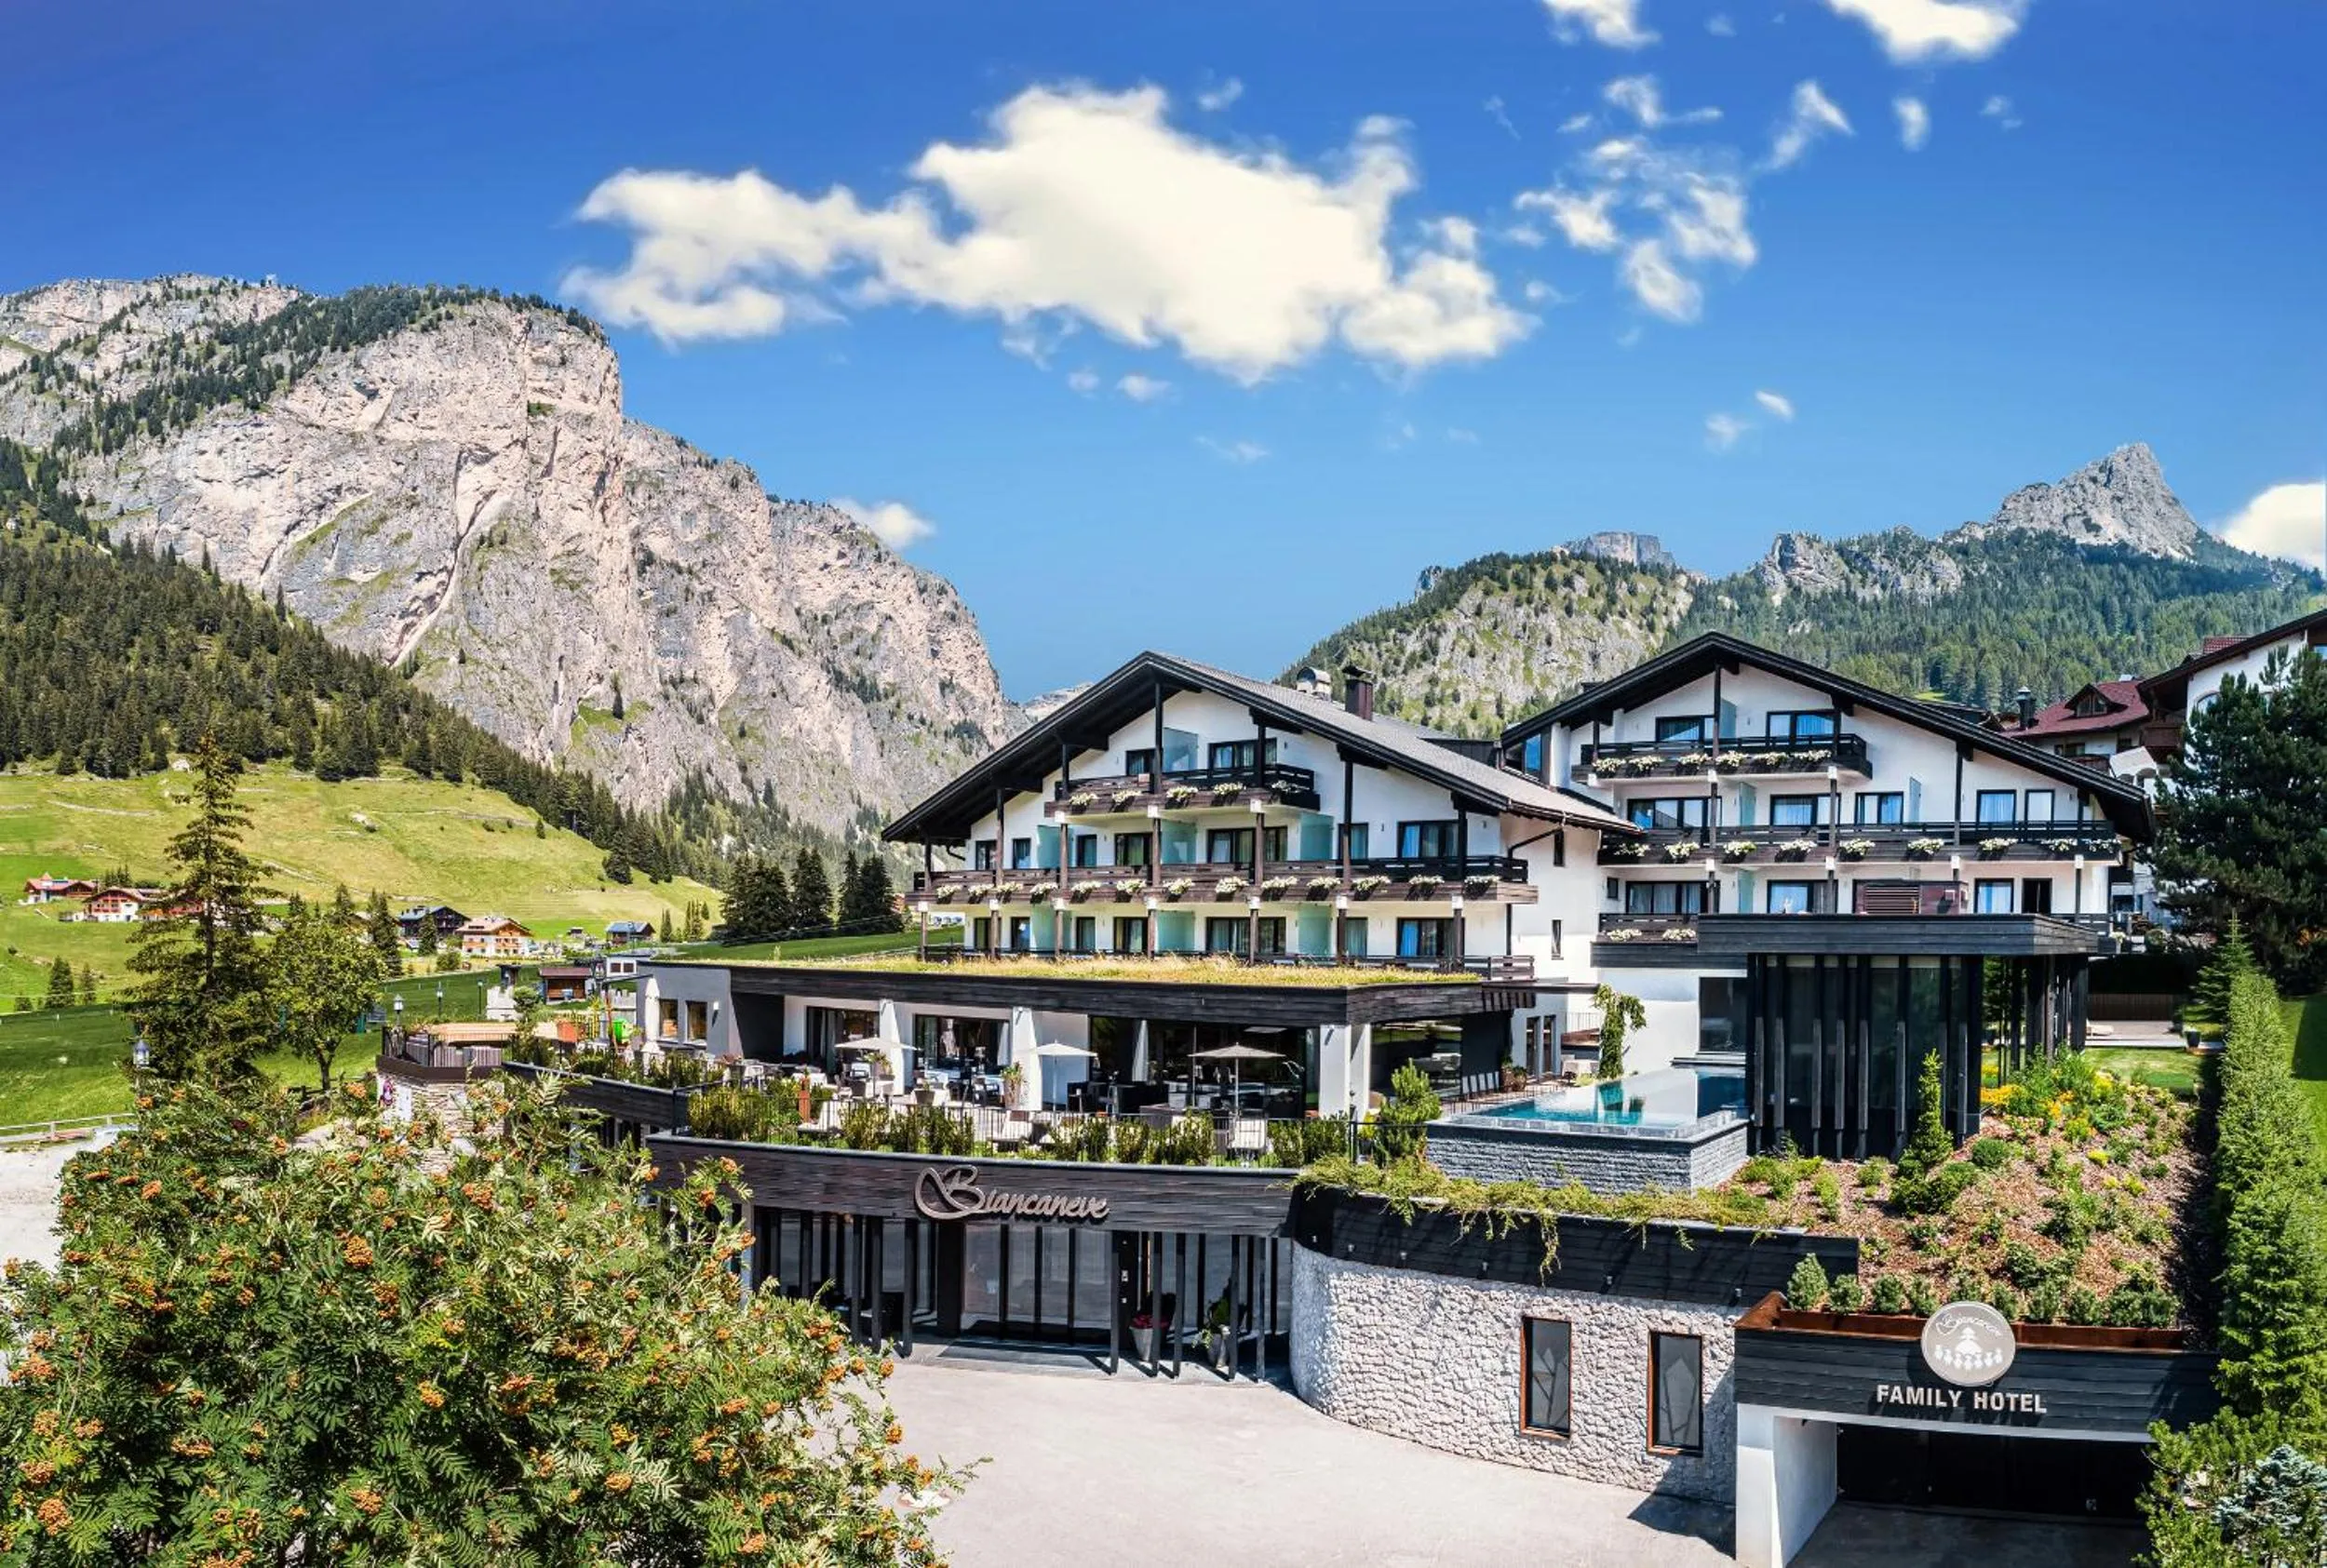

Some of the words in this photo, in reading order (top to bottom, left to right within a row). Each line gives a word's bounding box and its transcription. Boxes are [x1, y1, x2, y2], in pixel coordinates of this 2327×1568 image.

[915, 1164, 1110, 1219] Biancaneve
[1876, 1385, 1963, 1408] FAMILY
[1973, 1391, 2048, 1414] HOTEL
